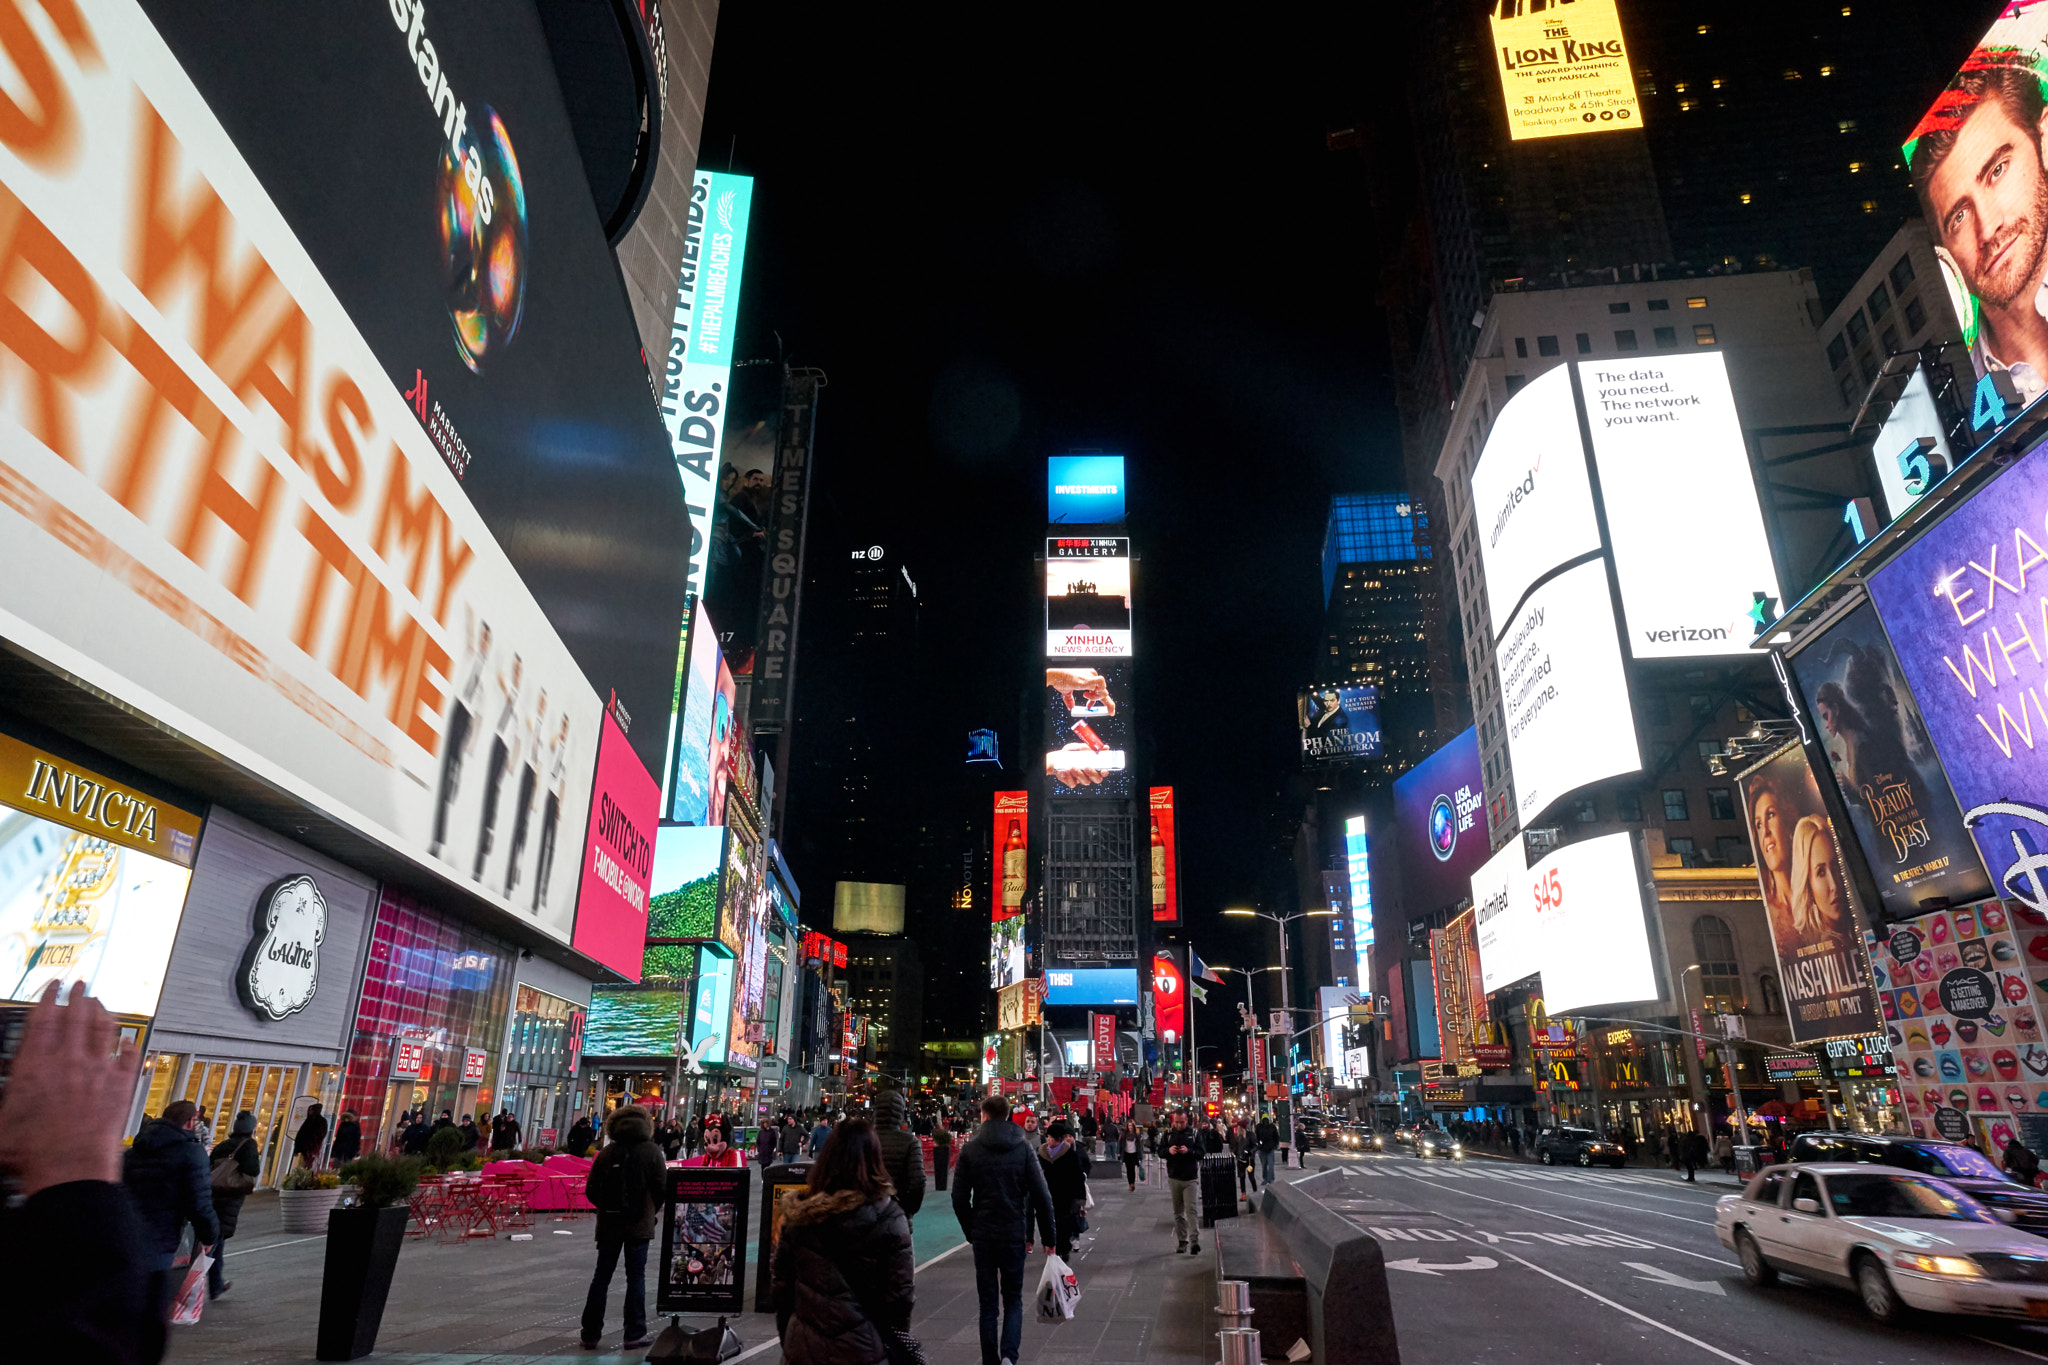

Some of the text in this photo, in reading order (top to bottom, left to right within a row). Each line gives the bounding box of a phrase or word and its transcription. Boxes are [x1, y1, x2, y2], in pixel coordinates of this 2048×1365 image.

[1543, 27, 1569, 37] THE
[1535, 62, 1619, 76] AWARD-WINNING
[1559, 72, 1600, 81] MUSICAL
[1538, 89, 1621, 103] Minskoff Theatre
[1514, 104, 1565, 116] Broadway
[1581, 98, 1604, 109] 45th
[1607, 97, 1636, 106] Street
[1523, 116, 1578, 127] lionking.com
[465, 146, 494, 225] as
[698, 232, 733, 354] #THEPALMBEACHES
[124, 70, 375, 515] WAS
[371, 433, 478, 632] MY
[1595, 369, 1664, 383] The data
[1598, 383, 1674, 399] you need.
[1601, 394, 1701, 411] The network
[1604, 411, 1680, 428] you want.
[433, 400, 472, 465] MARRIOTT
[676, 382, 722, 482] ADS.
[430, 418, 464, 476] MARQUIS
[1055, 484, 1118, 495] INVESTMENTS
[1490, 470, 1535, 549] unlimited
[764, 404, 809, 680] TIMES SQUARE
[1090, 539, 1117, 547] XINHUA
[1058, 548, 1118, 556] GALLERY
[290, 496, 456, 760] TIME
[719, 631, 735, 643] 17
[1645, 625, 1727, 643] verizon
[1065, 635, 1113, 645] XINHUA
[1500, 607, 1545, 671] Unbelievably
[1516, 654, 1552, 707] unlimited
[1345, 700, 1377, 708] FANTASIES
[1520, 685, 1559, 732] everyone.
[1303, 731, 1380, 751] PHANTOM
[1330, 728, 1350, 736] THE
[1310, 748, 1322, 756] OF
[1343, 743, 1375, 752] OPERA
[25, 759, 159, 842] INVICTA
[1455, 784, 1471, 804] USA
[1860, 776, 1914, 826] BEAUTY
[1456, 792, 1482, 818] TODAY
[599, 792, 650, 879] SWITCH TO
[1881, 818, 1930, 864] BEAST
[593, 845, 645, 914] T-MOBILE @WORK
[961, 848, 973, 909] NOVOTEL
[1893, 874, 1901, 883] IN
[1899, 866, 1924, 880] THEATRES
[1923, 859, 1943, 872] MARCH
[1675, 889, 1698, 900] THE
[1702, 889, 1737, 900] SHOW
[1477, 884, 1508, 926] unlimited
[25, 945, 74, 965] IVICTA
[1049, 973, 1073, 986] THIS!
[1783, 949, 1866, 1001] NASHVILLE
[1438, 938, 1458, 1033] PALACE
[1950, 985, 1982, 999] IS GETTING
[1840, 996, 1862, 1015] CMT
[1955, 996, 1988, 1011] MAKEOVER!
[1100, 1017, 1110, 1052] LOVE
[1607, 1029, 1633, 1046] EXPRESS
[1826, 1039, 1857, 1058] GIFTS
[1769, 1058, 1816, 1069] ELECTRONICS
[1872, 1054, 1883, 1065] NY
[1209, 1081, 1219, 1101] tkts
[1475, 1230, 1656, 1249] ONLY
